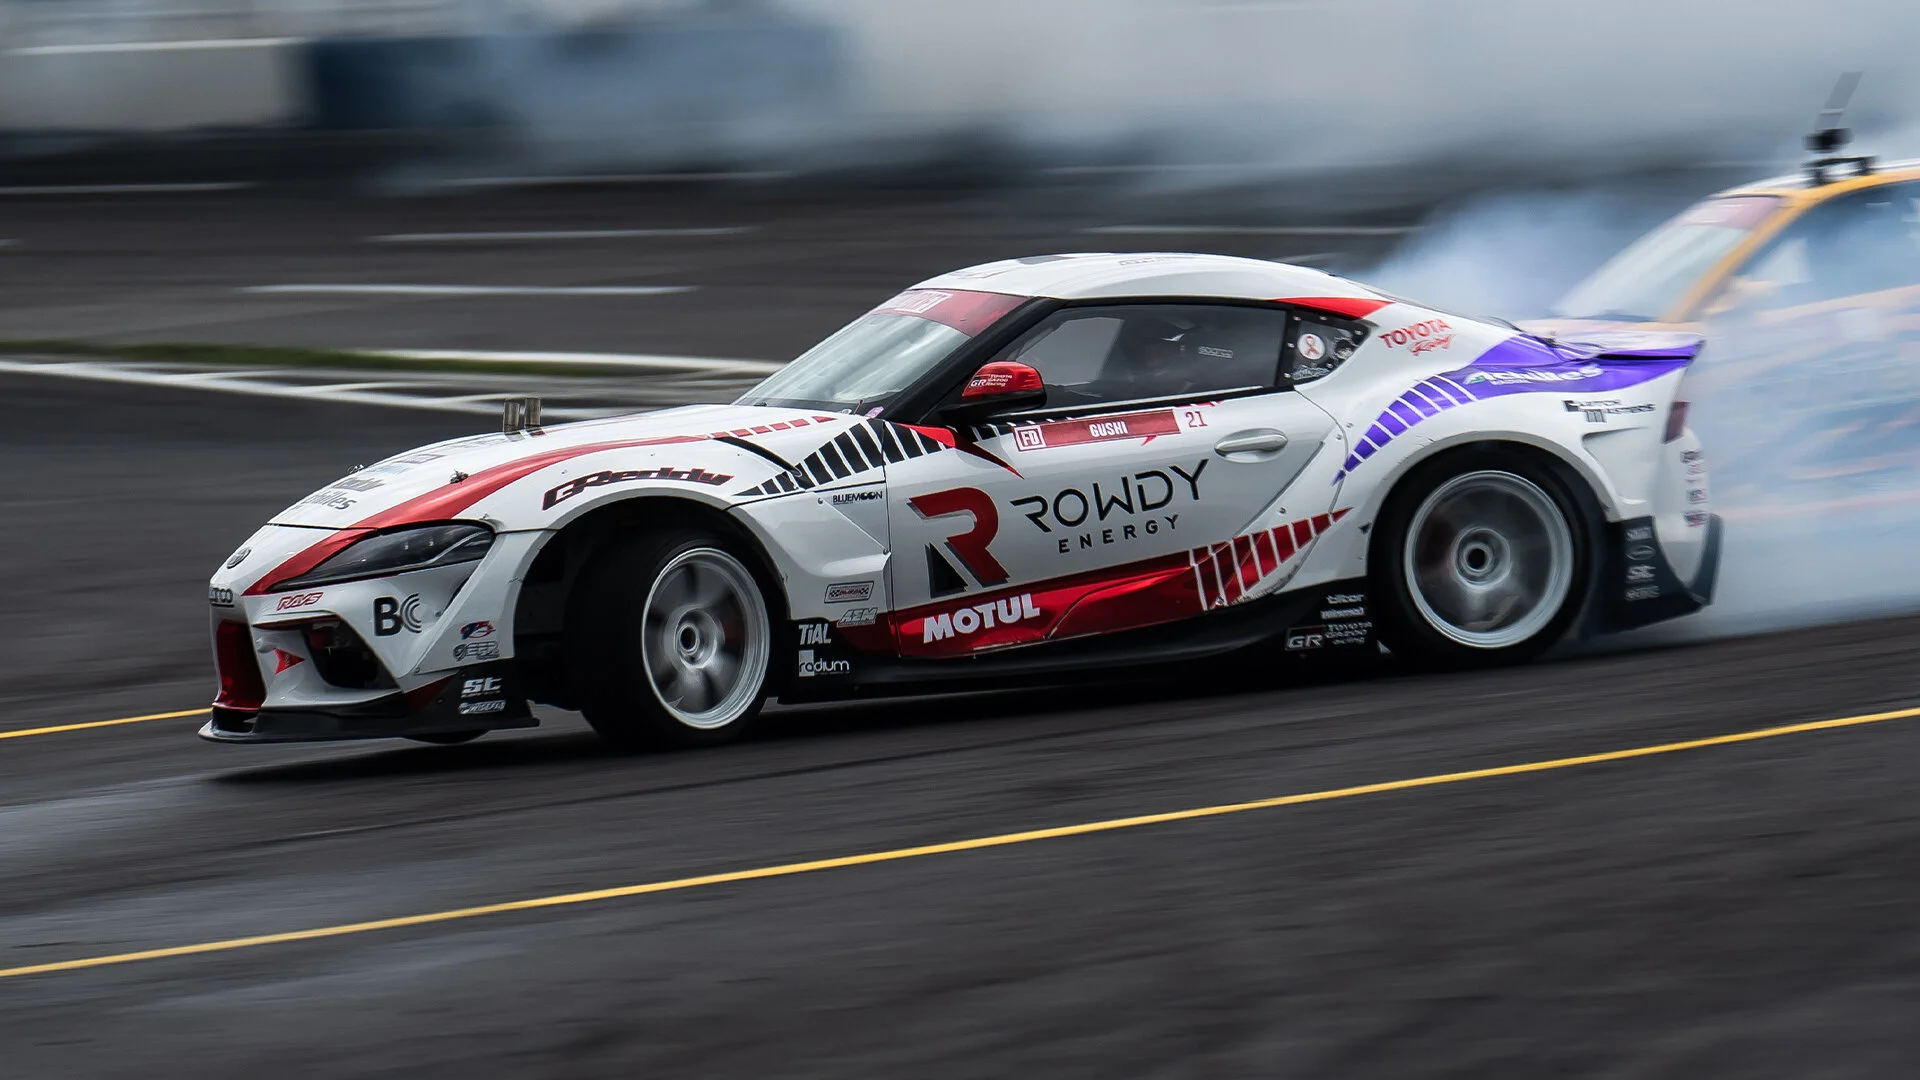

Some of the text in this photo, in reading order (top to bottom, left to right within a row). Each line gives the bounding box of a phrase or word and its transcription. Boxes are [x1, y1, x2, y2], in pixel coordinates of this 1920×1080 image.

[1378, 318, 1453, 349] TOYOTA
[1463, 363, 1605, 386] Achilles
[1088, 420, 1129, 438] GUSHI
[1184, 410, 1209, 429] 21
[1020, 430, 1041, 446] FD
[832, 490, 883, 503] BLUEMOON
[1009, 458, 1209, 533] ROWDY
[1057, 514, 1179, 554] ENERGY
[275, 591, 324, 611] RAYS
[840, 607, 878, 623] AEM
[923, 593, 1040, 644] MOTUL
[1288, 634, 1323, 649] GR
[799, 657, 850, 673] radium
